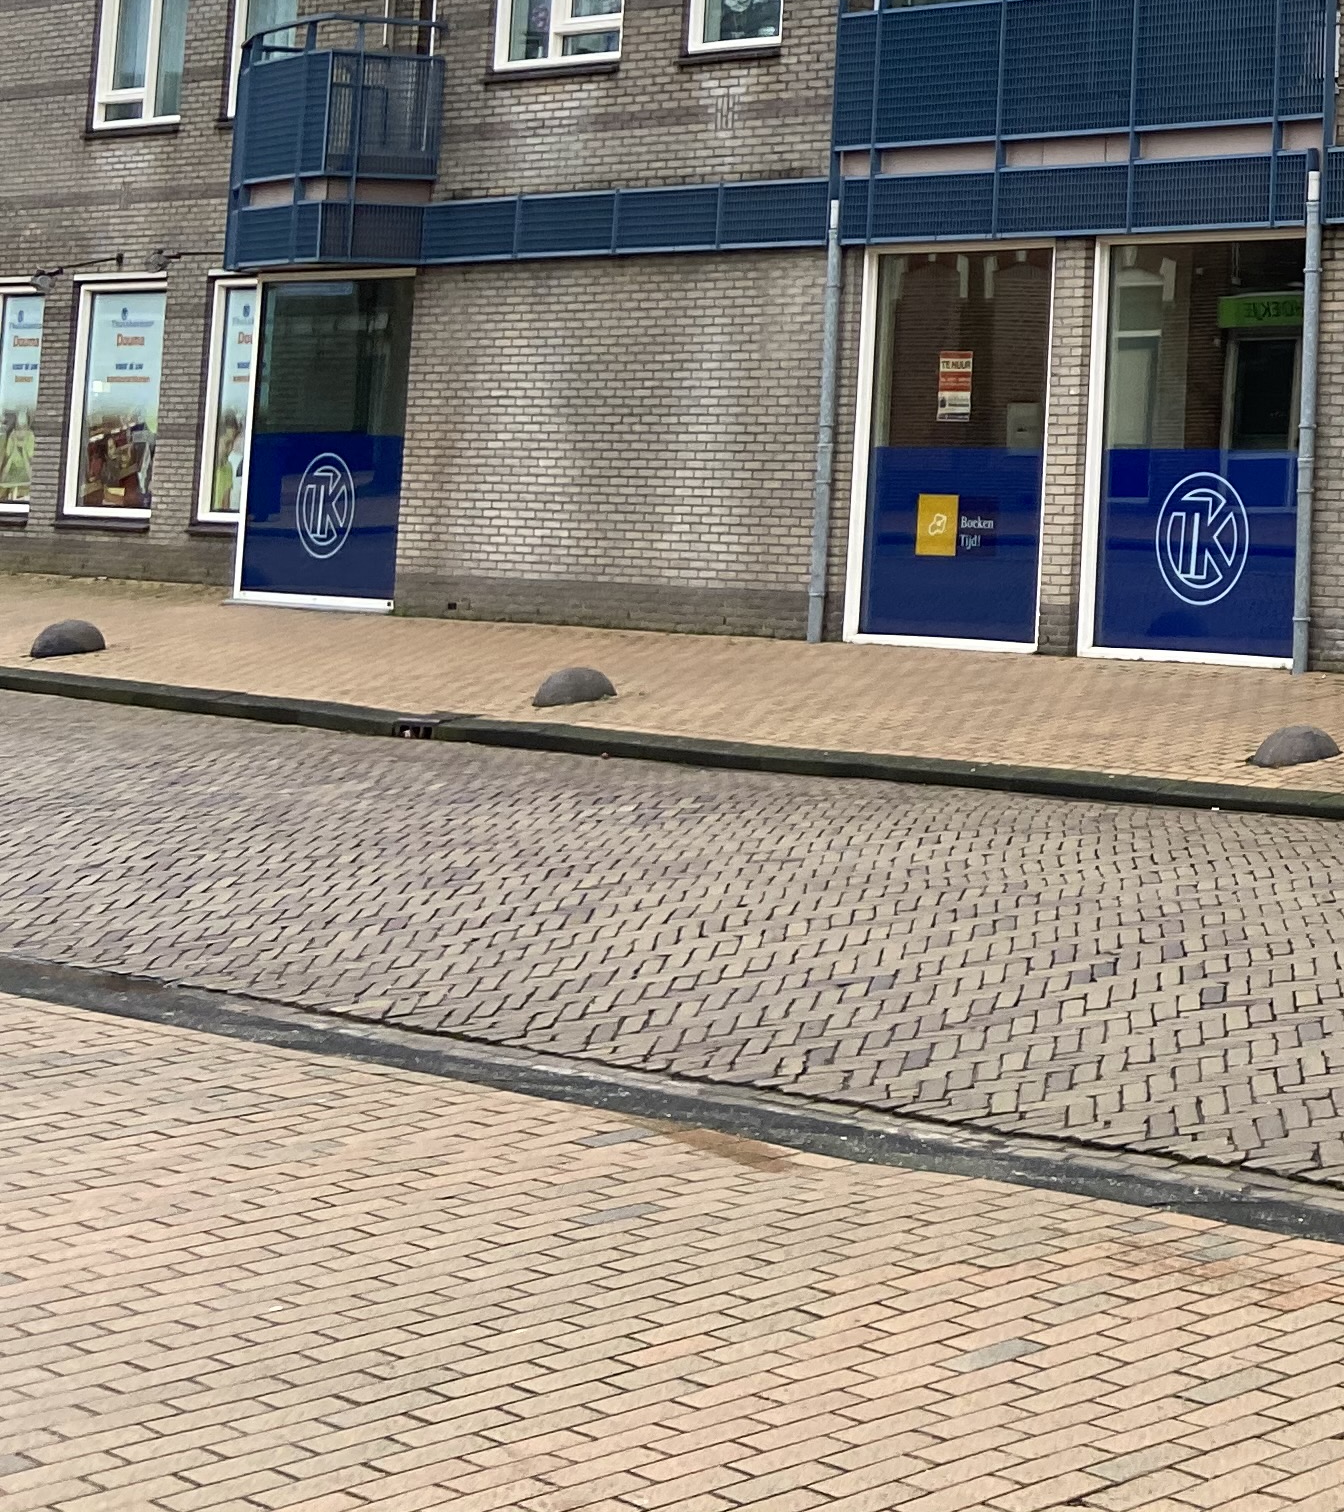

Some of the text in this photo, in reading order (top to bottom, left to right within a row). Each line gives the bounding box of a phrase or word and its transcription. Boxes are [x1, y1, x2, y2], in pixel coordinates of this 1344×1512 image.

[941, 360, 950, 369] TE
[961, 515, 994, 529] Boeken
[960, 534, 981, 550] Tijd!
